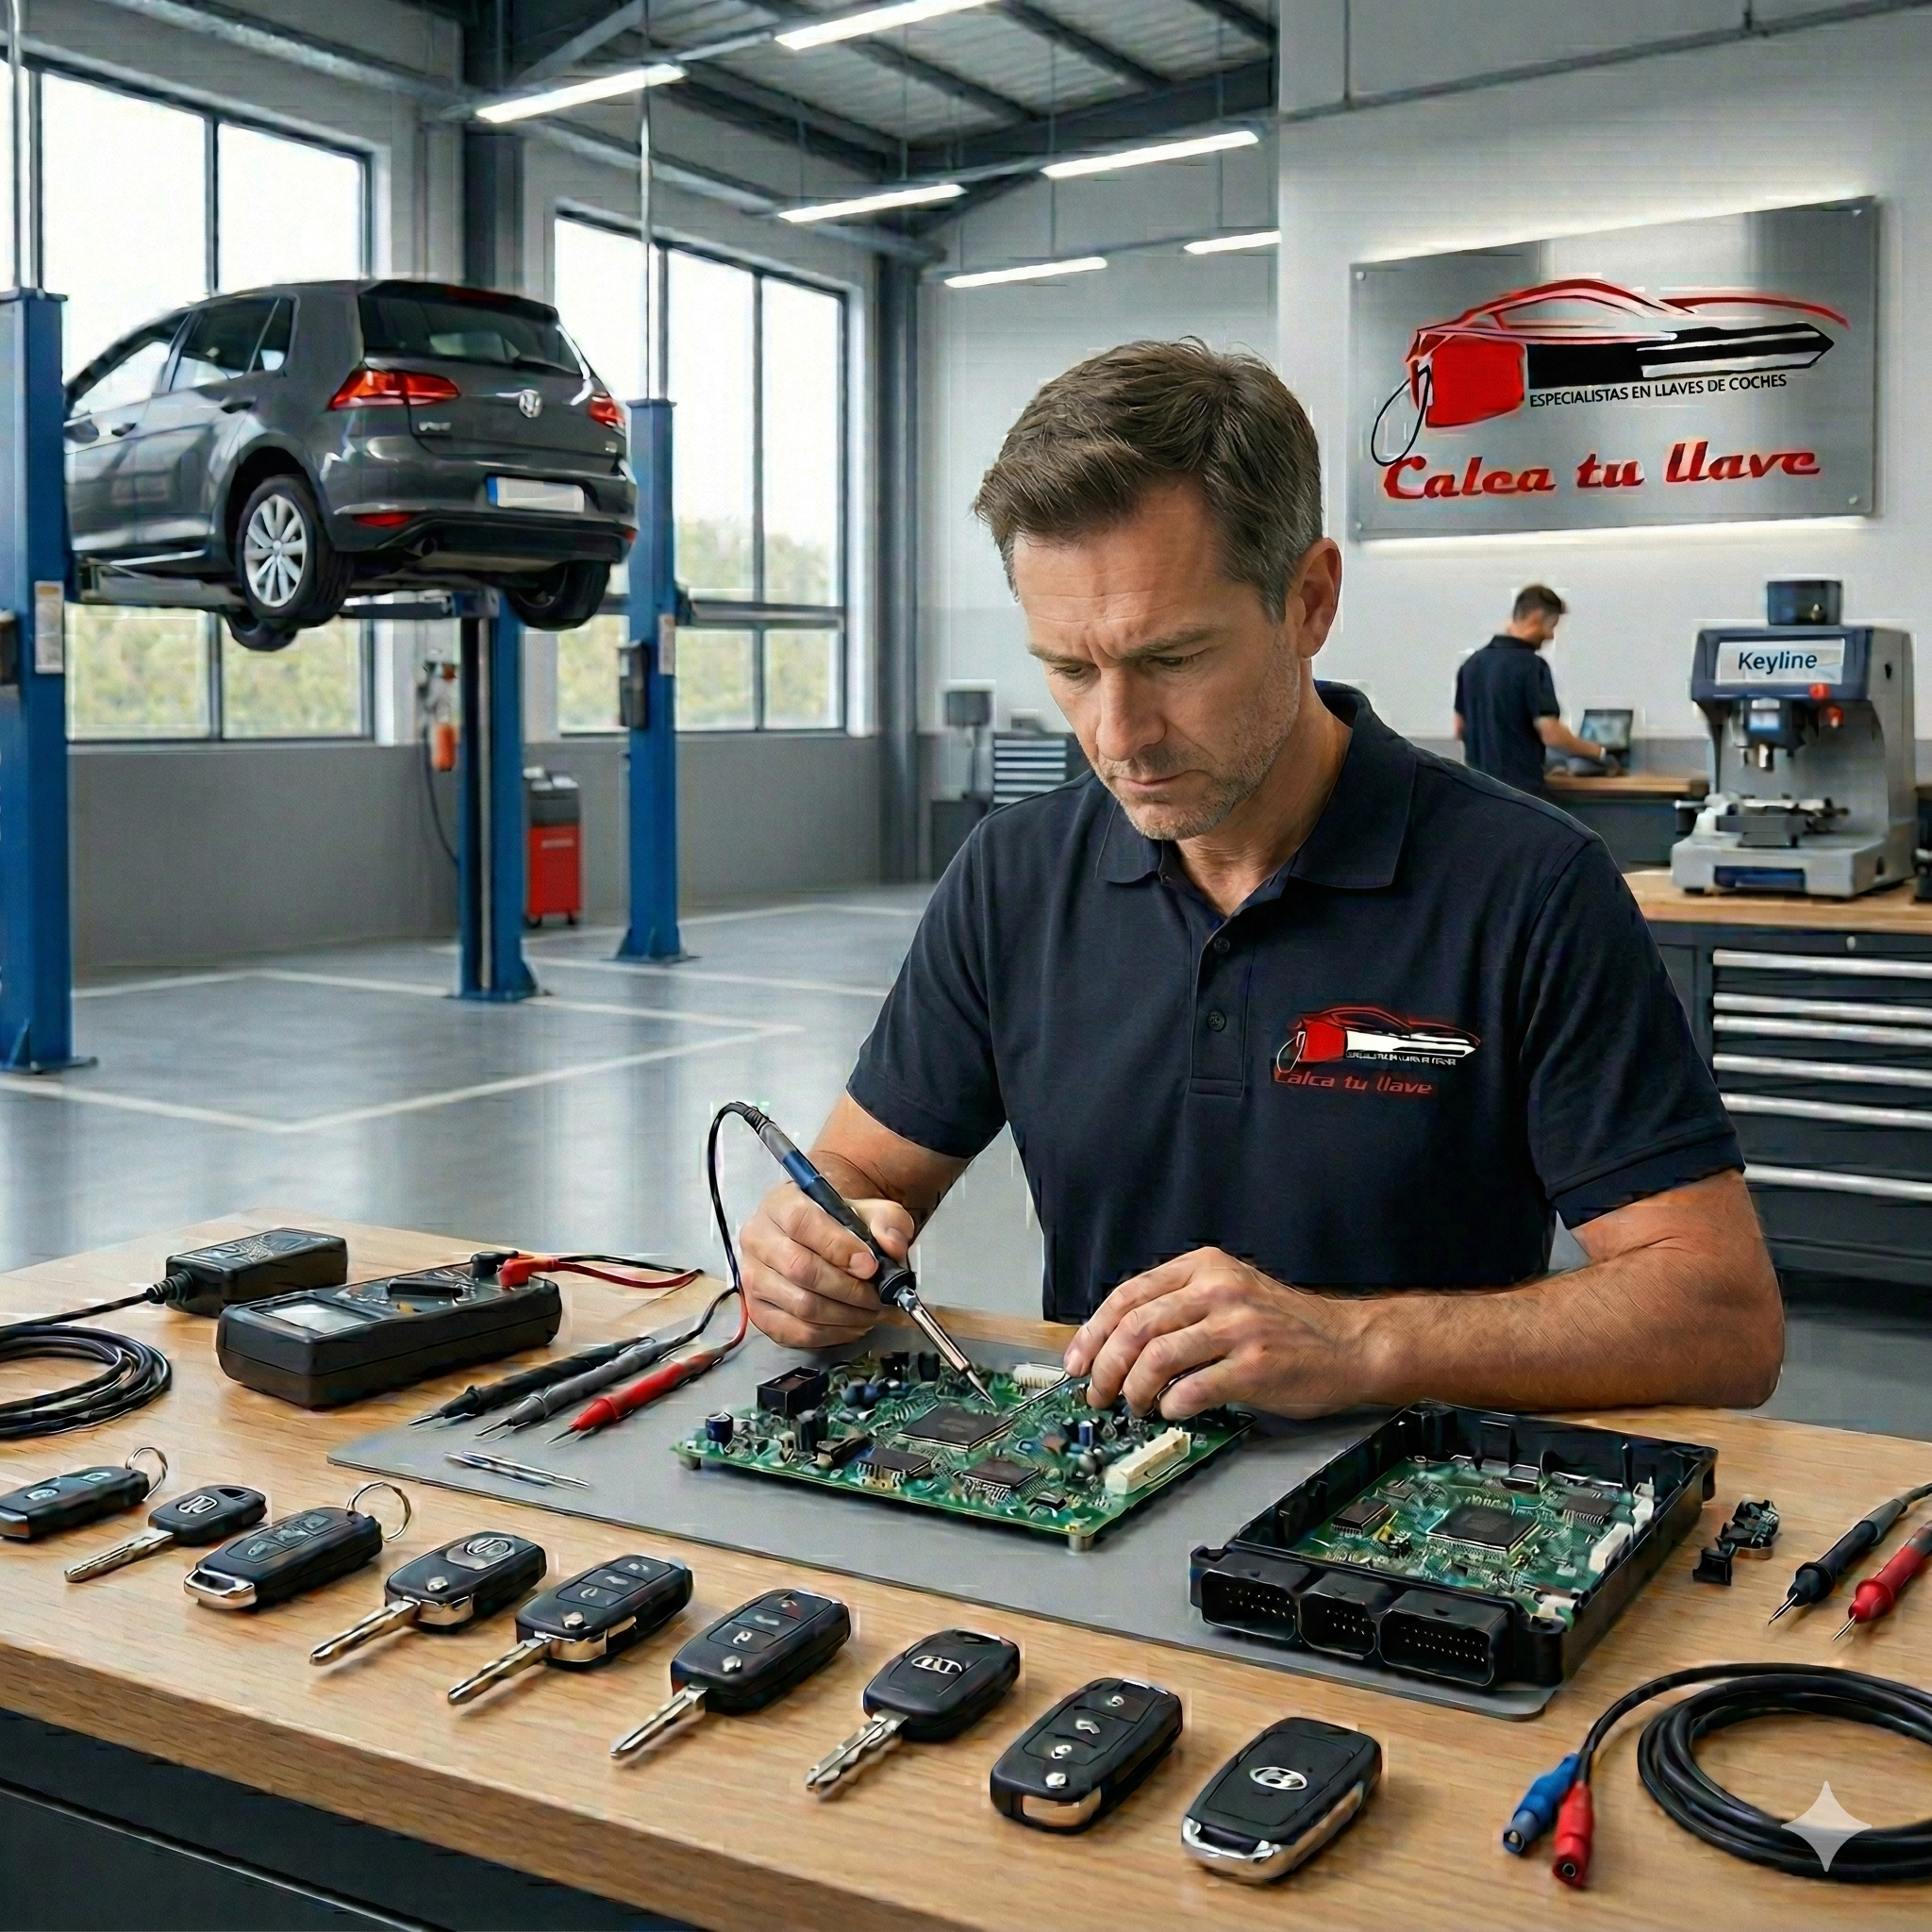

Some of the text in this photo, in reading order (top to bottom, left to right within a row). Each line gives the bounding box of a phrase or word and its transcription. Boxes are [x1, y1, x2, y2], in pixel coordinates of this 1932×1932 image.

[1529, 374, 1788, 407] ESPECIALISTAS EN LLAVES DE COCHES
[1384, 441, 1822, 500] Calca tu llave
[1738, 650, 1818, 675] Keyline
[1343, 1074, 1369, 1091] tu
[1376, 1075, 1433, 1094] llave
